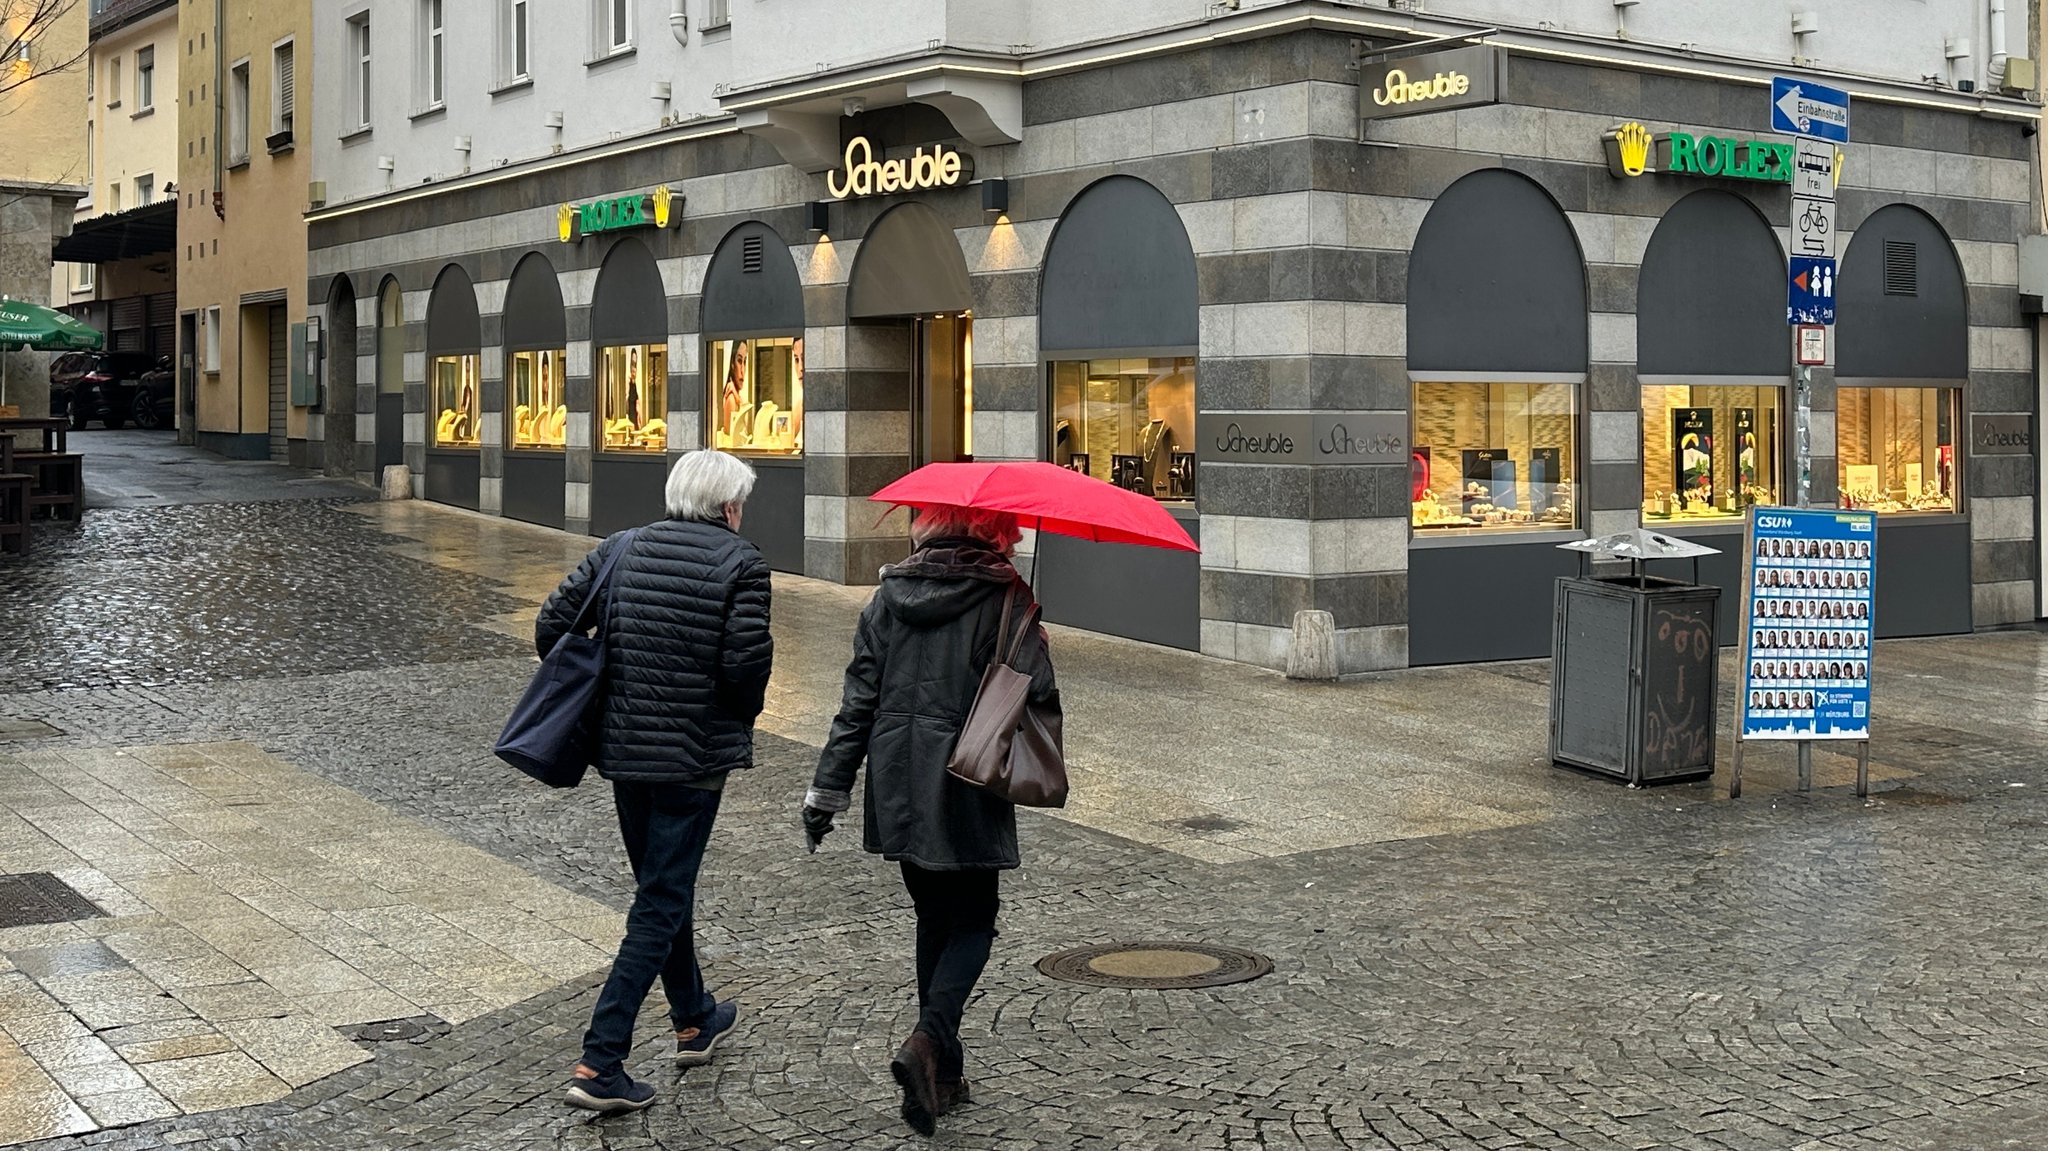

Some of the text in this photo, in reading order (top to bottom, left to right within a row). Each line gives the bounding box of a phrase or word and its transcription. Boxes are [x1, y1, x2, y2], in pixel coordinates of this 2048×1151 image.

[1373, 69, 1469, 106] Scheuble
[1798, 101, 1845, 122] Einbahnstraße
[827, 136, 961, 198] Scheuble
[1669, 132, 1794, 182] ROLEX
[1807, 176, 1821, 190] frei
[579, 193, 646, 233] ROLEX
[1216, 423, 1294, 454] Scheuble
[1319, 423, 1402, 455] Scheuble
[1976, 421, 2030, 447] Scheuble
[1757, 516, 1782, 528] CSU
